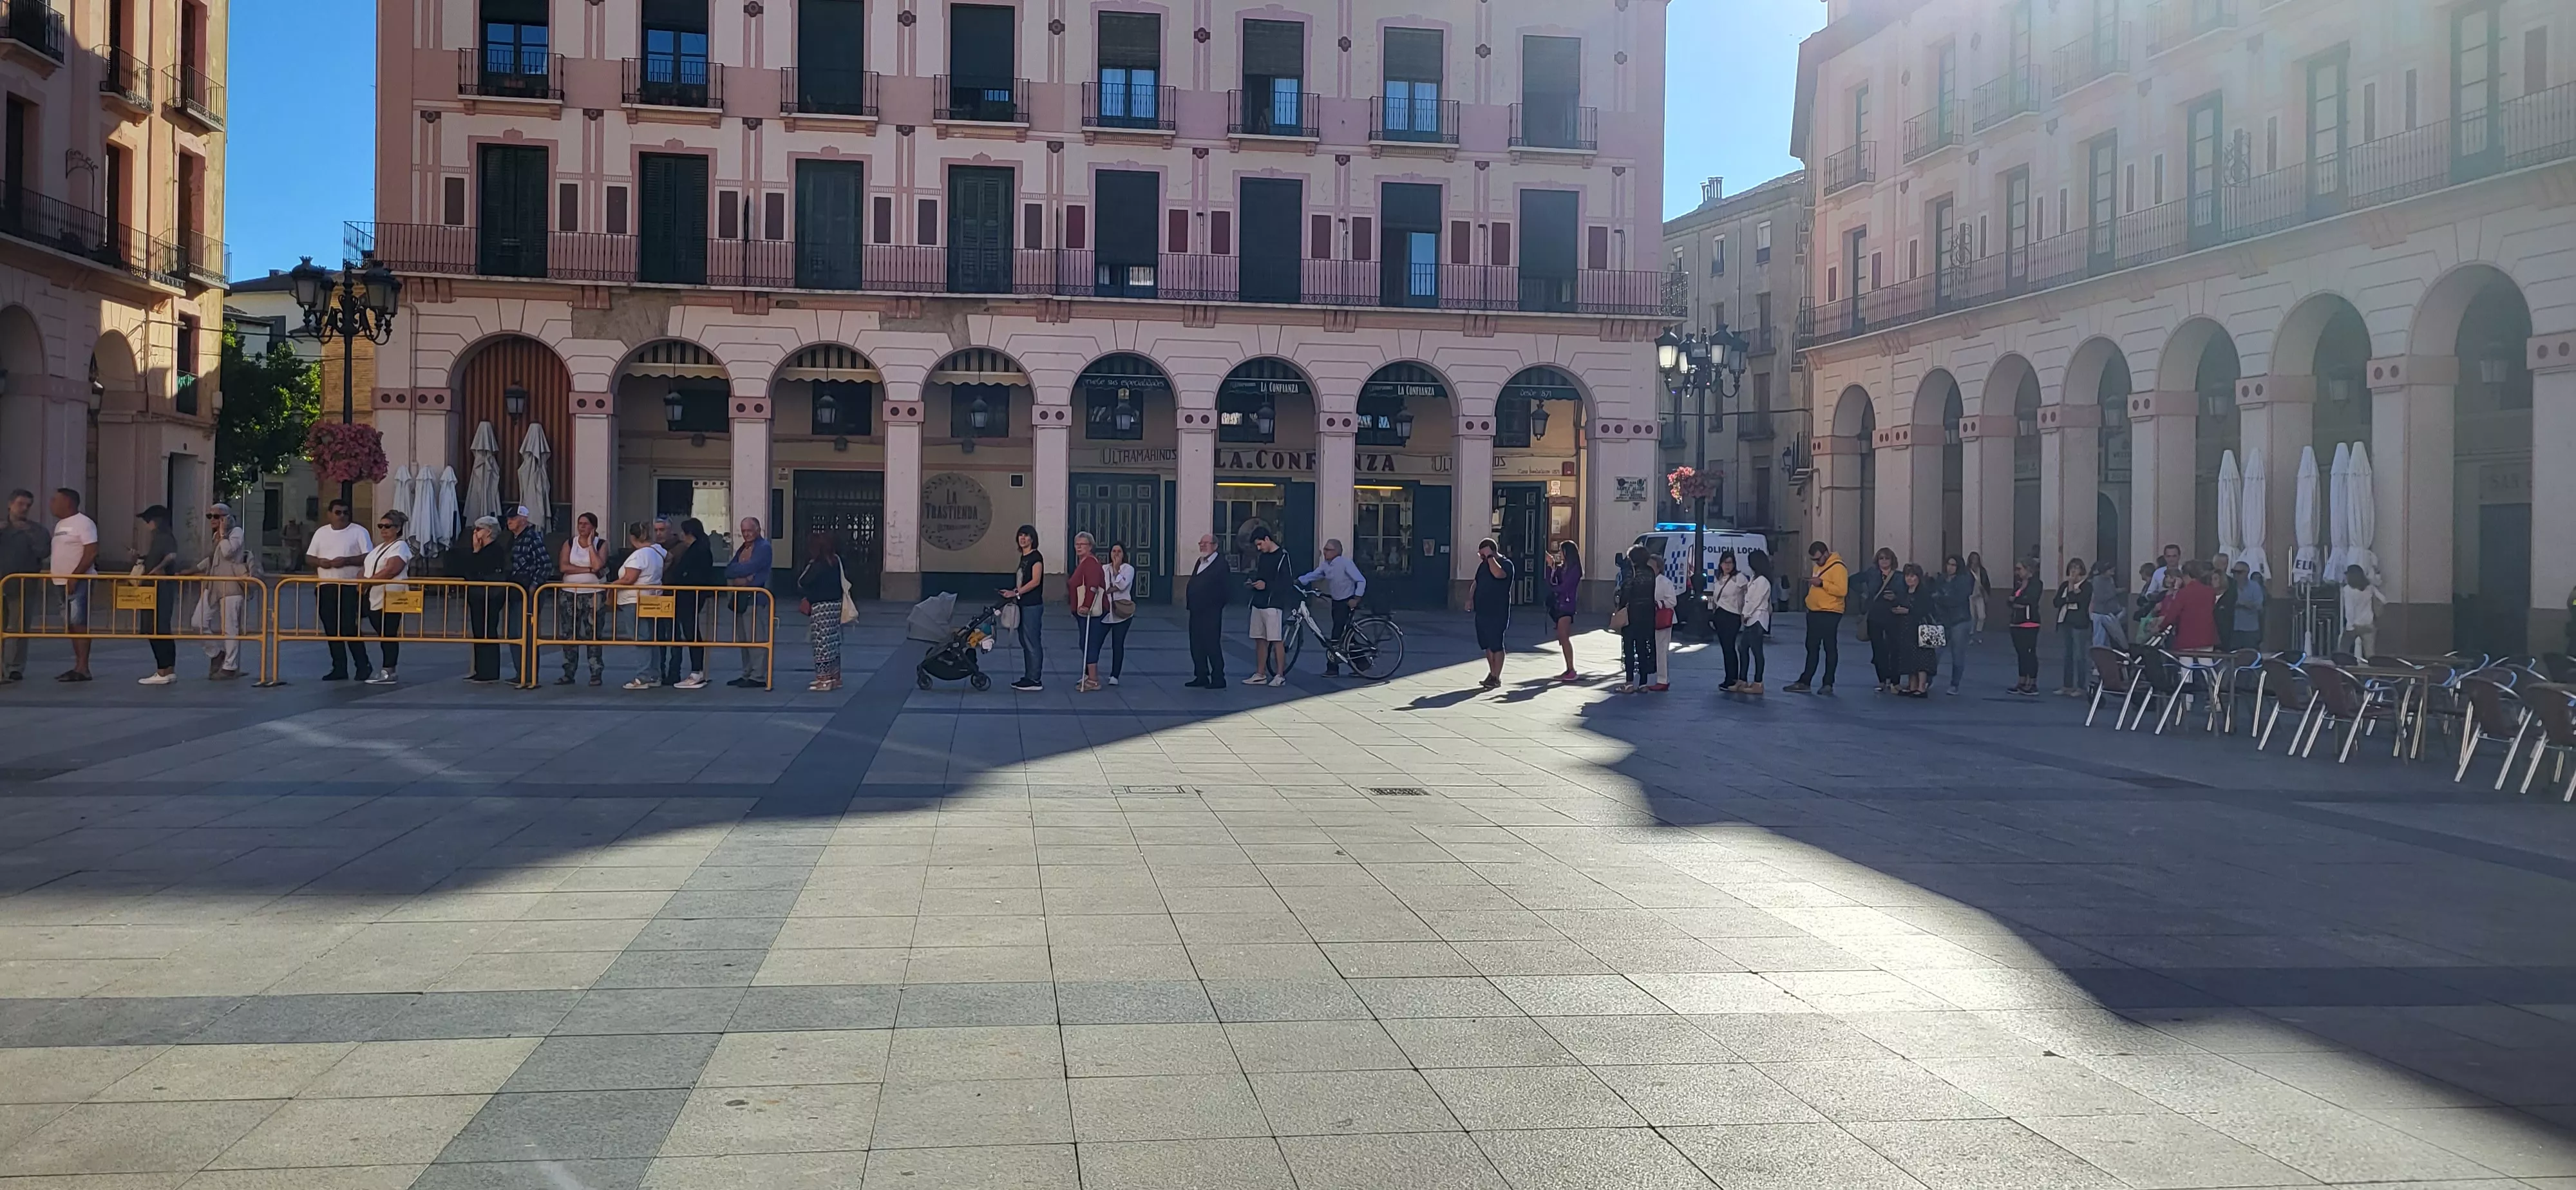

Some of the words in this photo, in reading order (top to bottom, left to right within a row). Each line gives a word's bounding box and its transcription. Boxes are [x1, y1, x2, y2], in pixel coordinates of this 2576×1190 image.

[1260, 381, 1268, 392] LA
[1269, 381, 1299, 393] CONFIANZA
[1397, 384, 1405, 395] LA
[1406, 385, 1435, 396] CONFIANZA
[1101, 448, 1177, 464] ULTRAMARINOS
[946, 488, 957, 505] LA
[925, 502, 978, 520] TRASTIENDA
